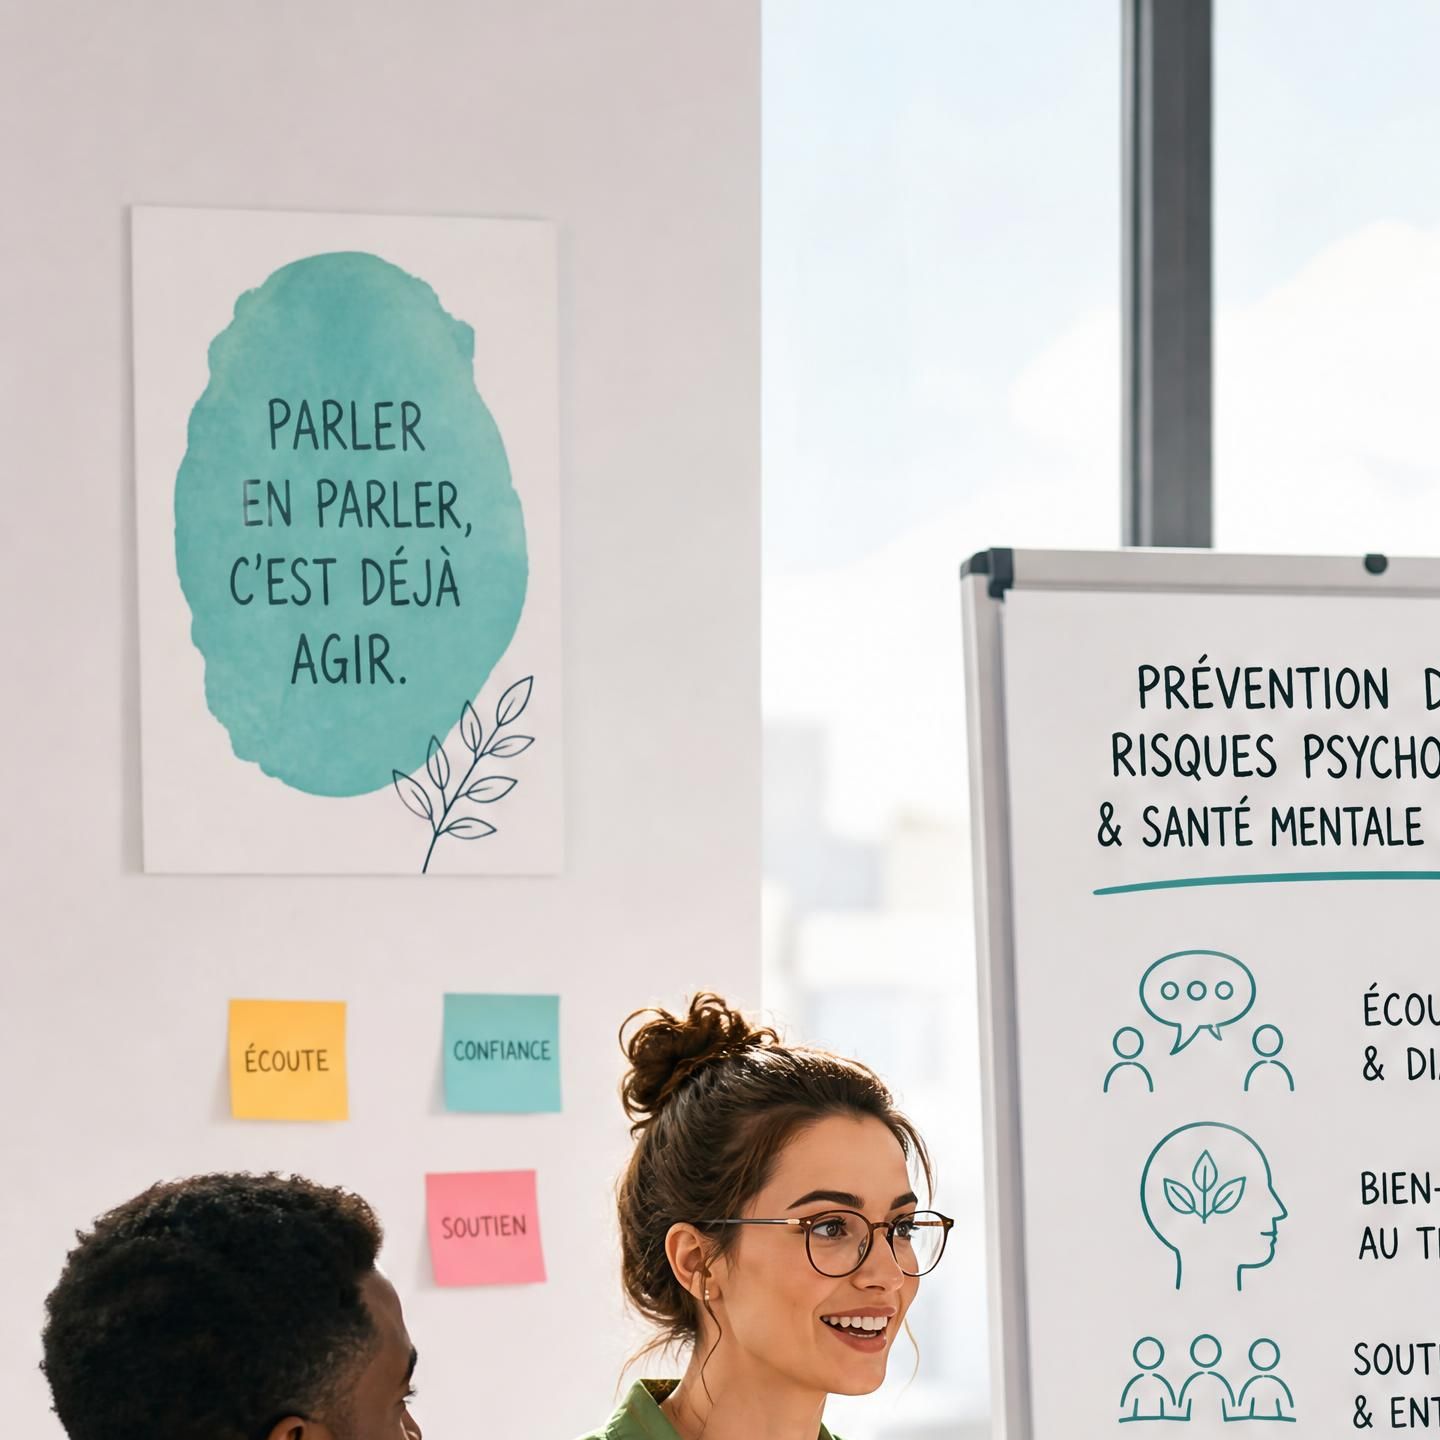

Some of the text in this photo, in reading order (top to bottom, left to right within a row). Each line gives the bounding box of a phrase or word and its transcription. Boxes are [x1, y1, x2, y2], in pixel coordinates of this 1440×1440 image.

[268, 397, 426, 452] PARLER
[243, 478, 472, 538] EN PARLER,
[229, 545, 461, 608] C'EST DÉJÀ
[290, 632, 407, 685] AGIR.
[1138, 653, 1389, 710] PRÉVENTION
[1111, 731, 1278, 782] RISQUES
[1097, 801, 1123, 848] &
[1142, 794, 1254, 848] SANTÉ
[1271, 806, 1425, 847] MENTALE
[244, 1042, 329, 1073] ÉCOUTE
[453, 1039, 551, 1062] CONFIANCE
[1362, 1045, 1385, 1082] &
[441, 1214, 527, 1240] SOUTIEN
[1358, 1225, 1399, 1260] AU
[1352, 1394, 1374, 1429] &
